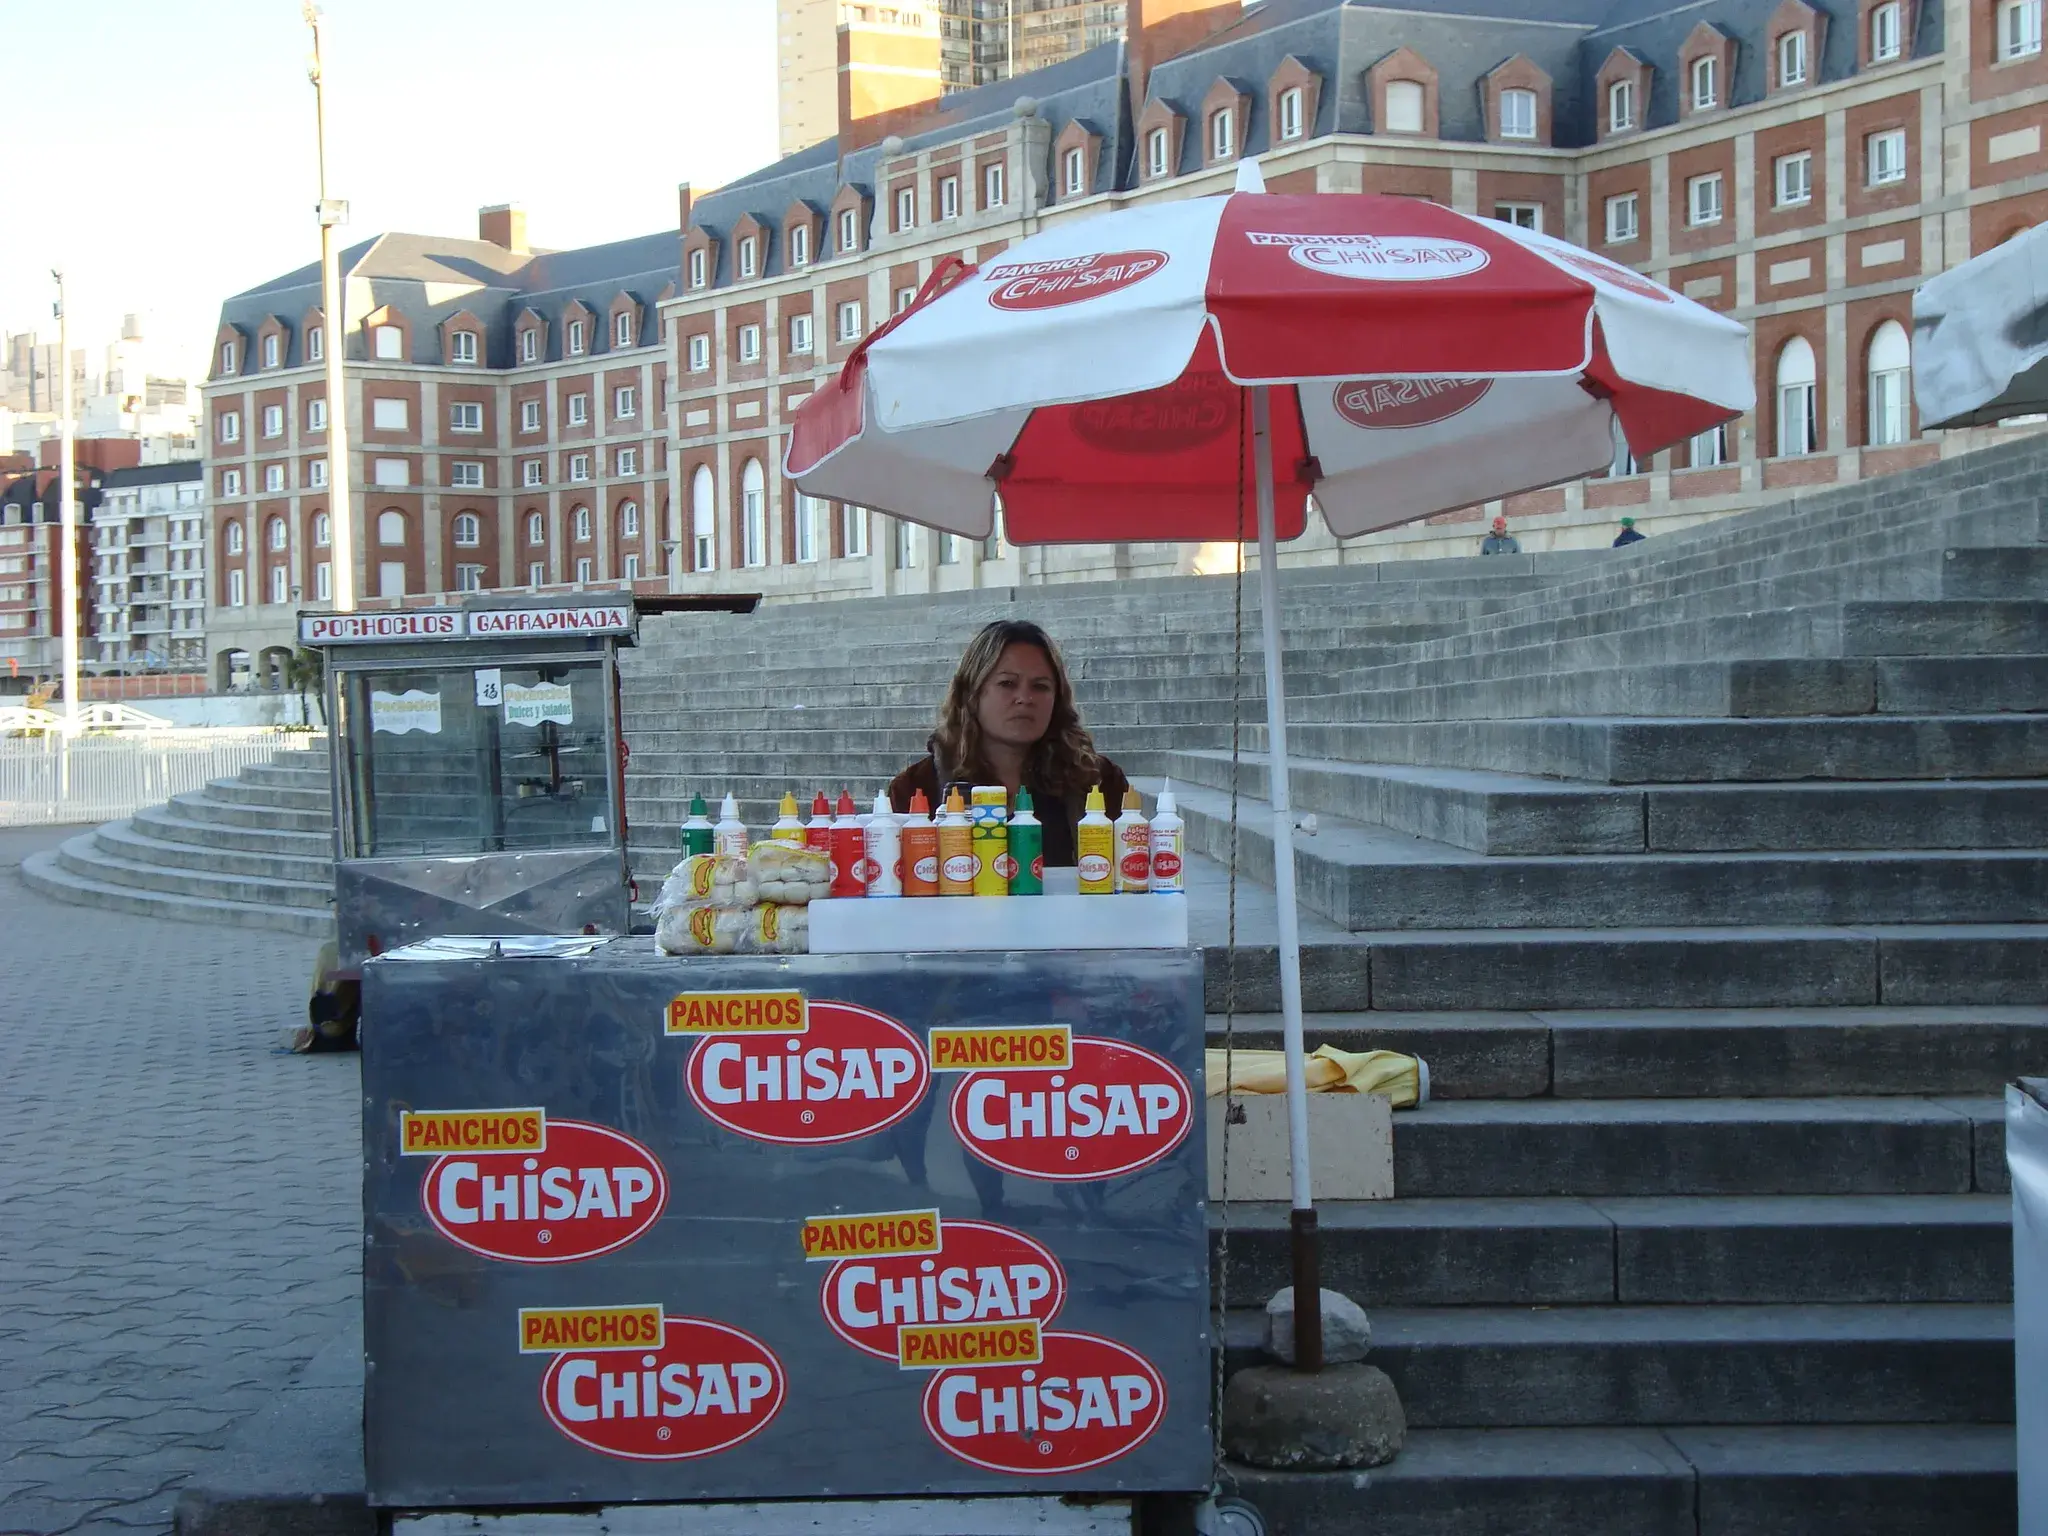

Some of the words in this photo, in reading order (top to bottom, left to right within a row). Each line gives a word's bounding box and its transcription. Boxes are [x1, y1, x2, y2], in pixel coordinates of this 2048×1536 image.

[1253, 233, 1372, 245] PANCHOS
[992, 255, 1095, 279] PANCHOS
[671, 997, 801, 1027] PANCHOS
[936, 1034, 1066, 1064] PANCHOS
[408, 1117, 539, 1147] PANCHOS
[804, 1218, 935, 1252] PANCHOS
[526, 1313, 657, 1345] PANCHOS
[905, 1328, 1035, 1361] PANCHOS
